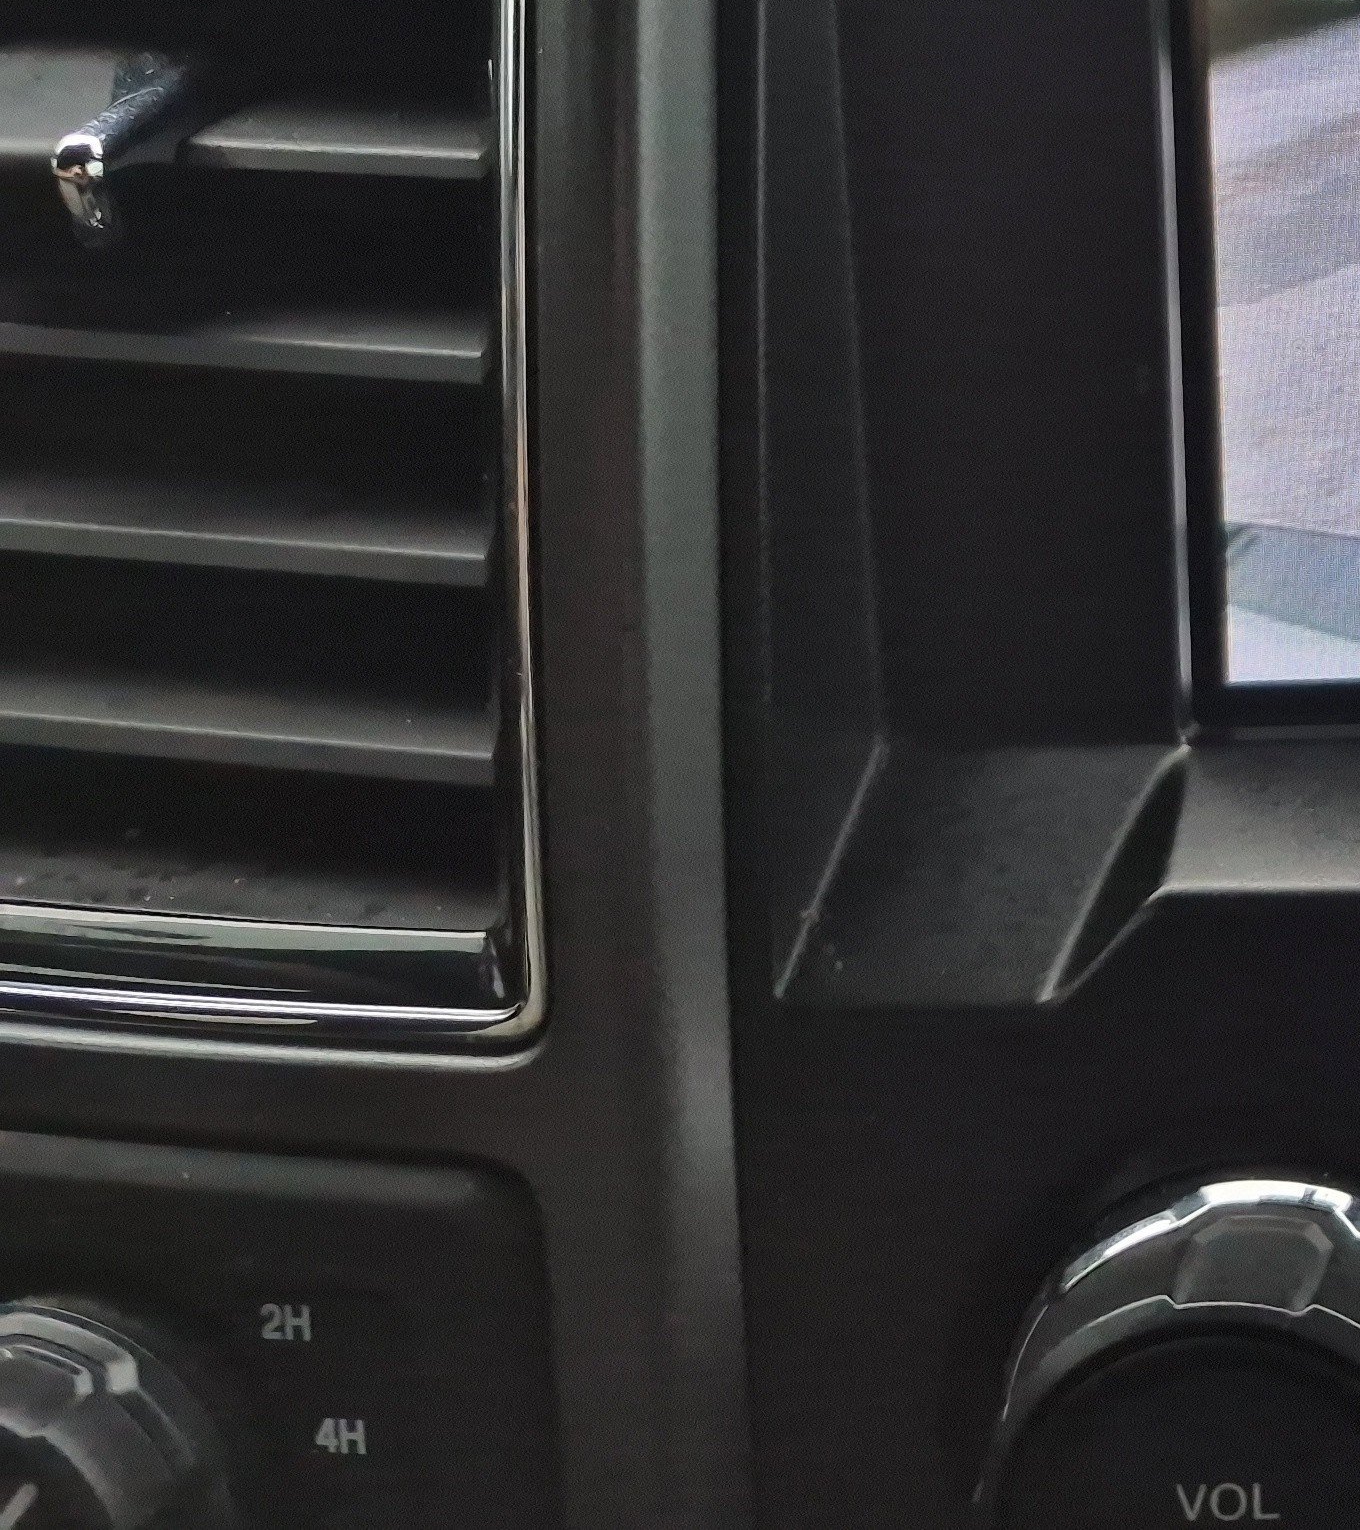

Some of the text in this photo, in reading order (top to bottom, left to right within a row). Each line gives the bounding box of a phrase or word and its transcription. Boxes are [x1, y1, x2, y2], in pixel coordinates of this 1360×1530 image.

[260, 1303, 312, 1342] 2H
[315, 1417, 367, 1456] 4H
[1176, 1482, 1280, 1522] VOL
